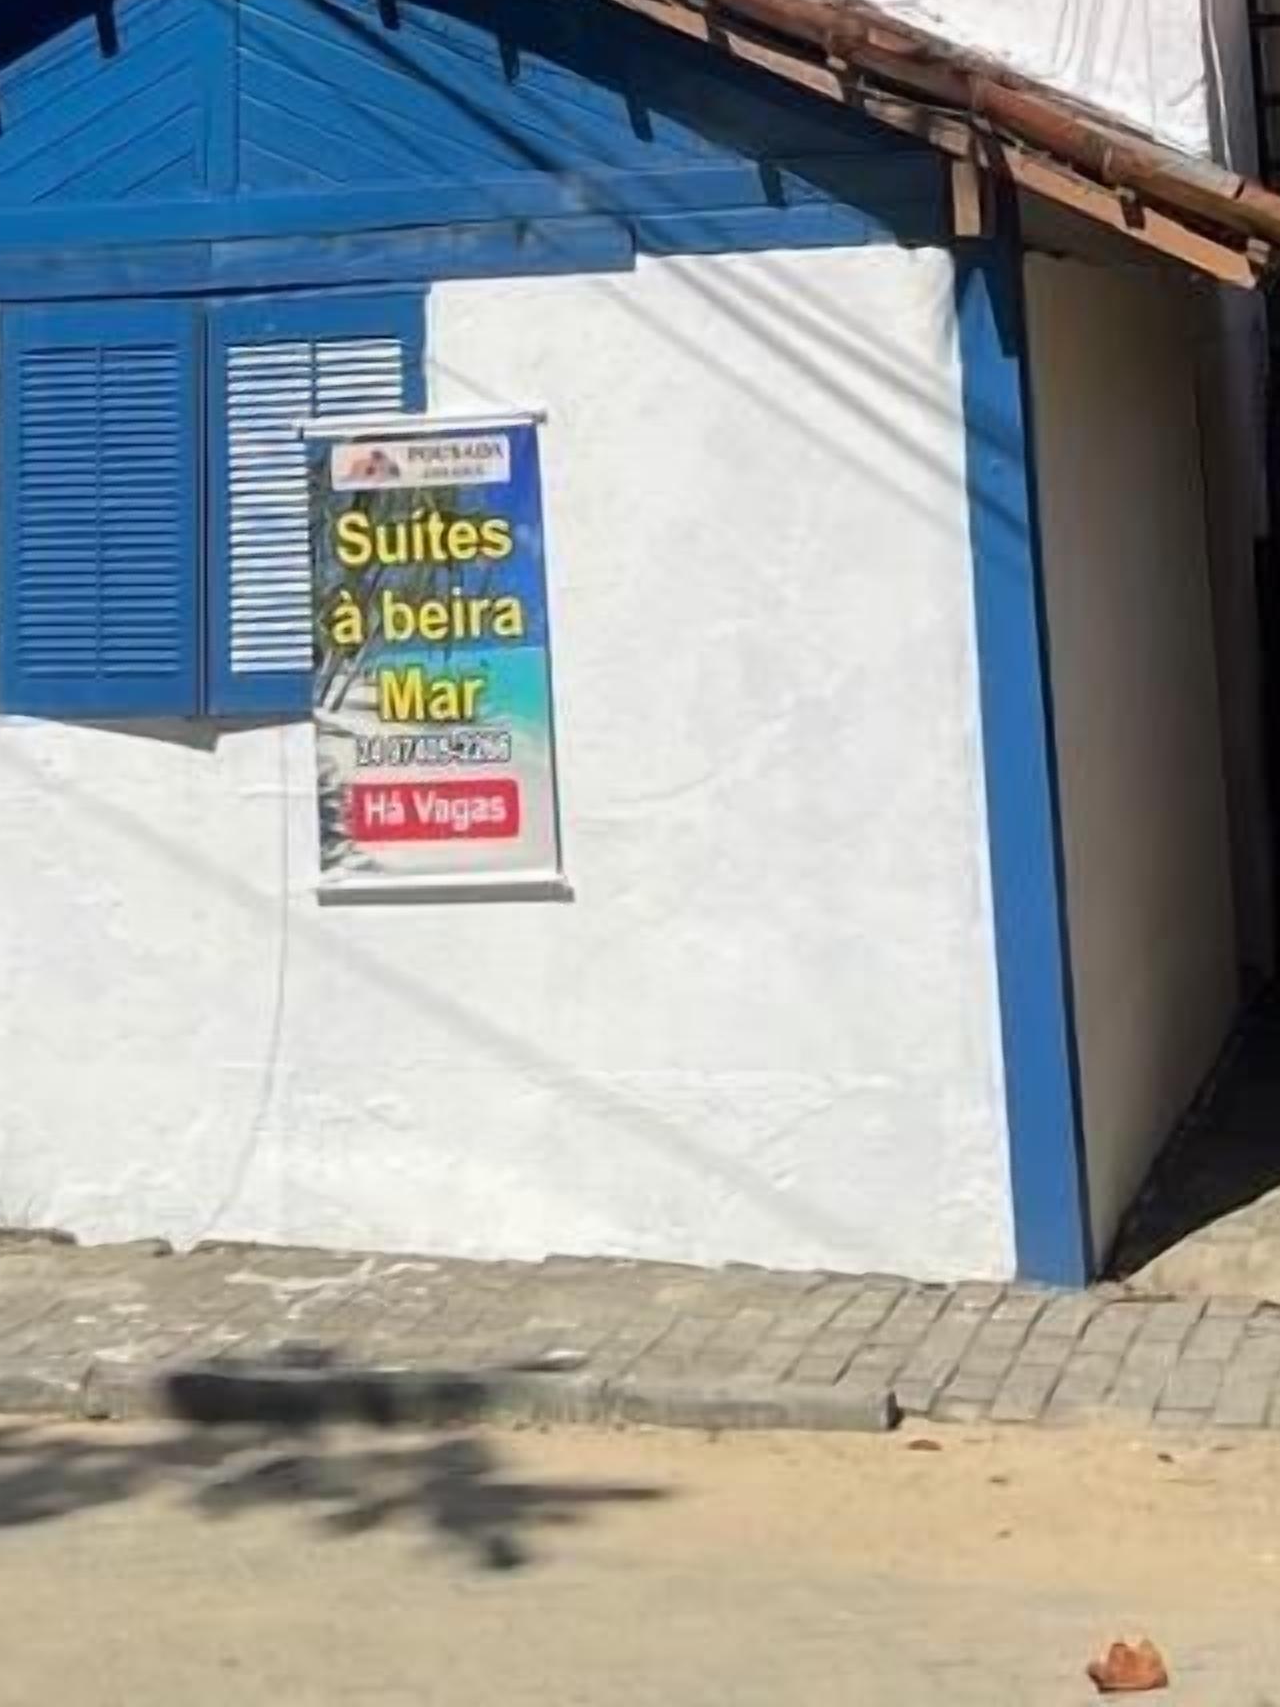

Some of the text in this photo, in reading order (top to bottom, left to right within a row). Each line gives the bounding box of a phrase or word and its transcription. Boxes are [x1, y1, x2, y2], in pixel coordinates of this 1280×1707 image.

[337, 508, 513, 566] Suítes
[332, 587, 524, 644] à beira
[380, 667, 486, 721] Mar
[363, 789, 508, 833] Há Vagas
